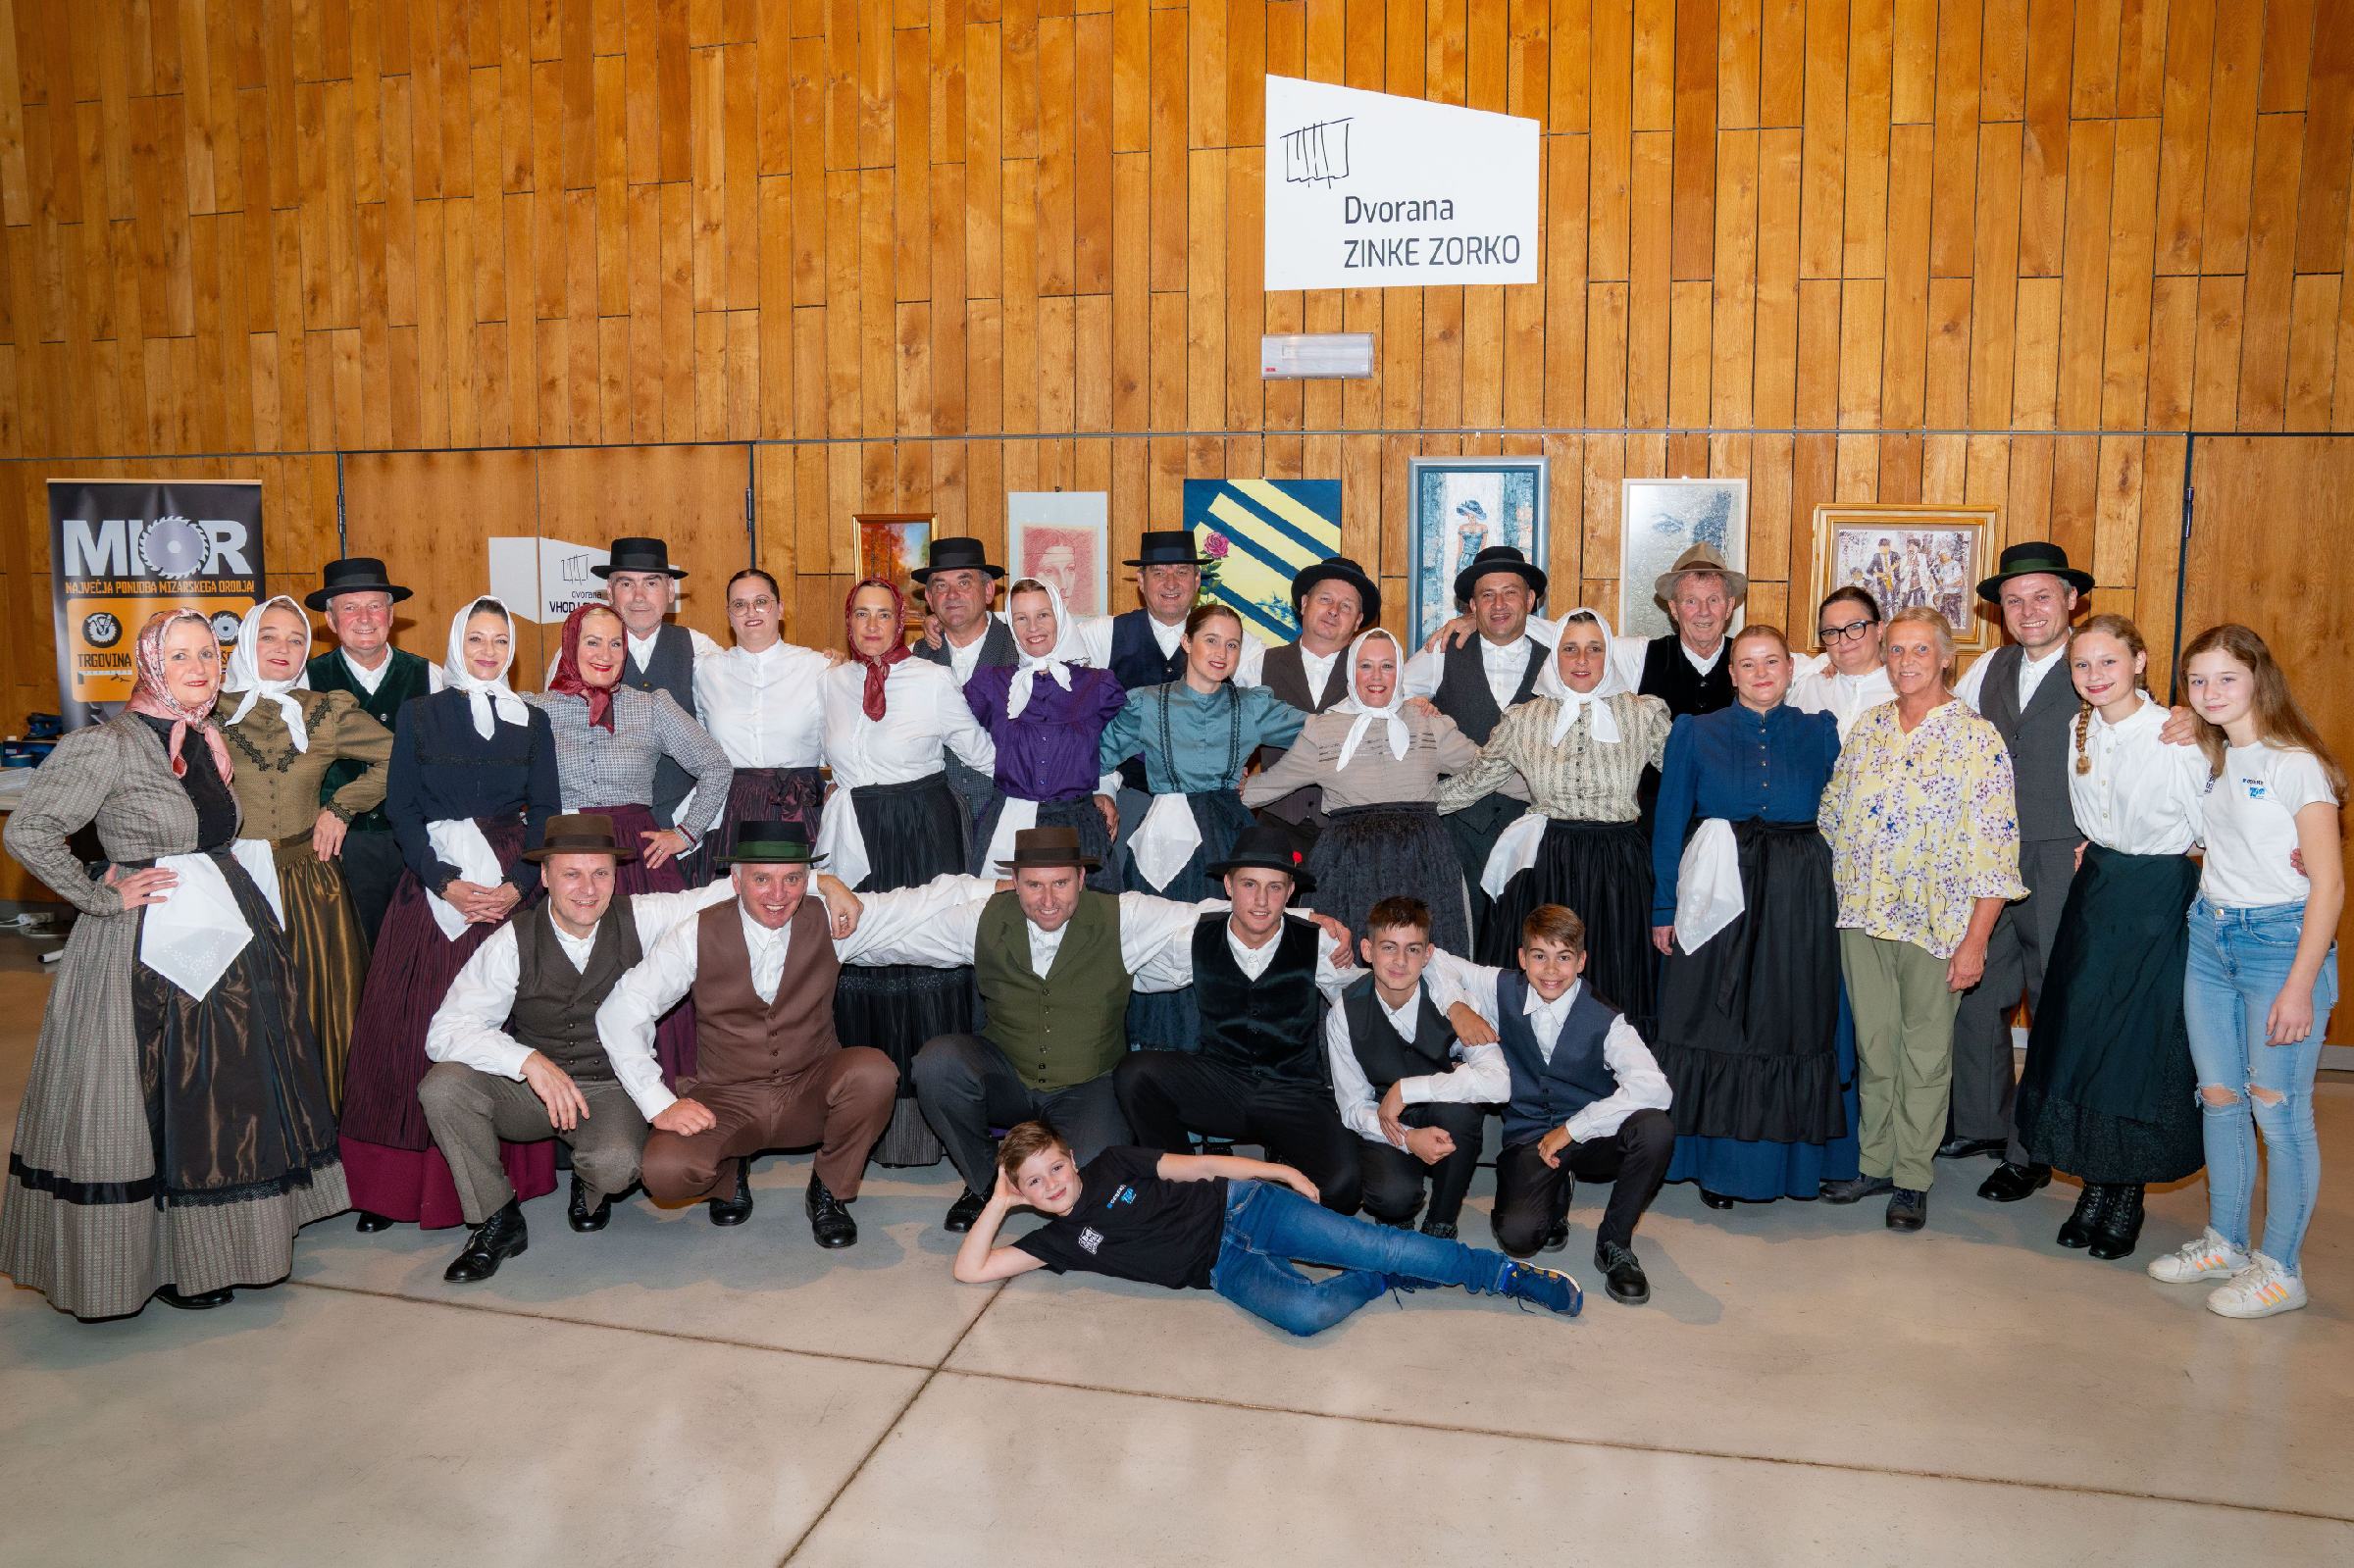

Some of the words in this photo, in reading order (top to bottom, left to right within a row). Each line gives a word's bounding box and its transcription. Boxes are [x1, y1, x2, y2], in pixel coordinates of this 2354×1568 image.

[1345, 195, 1454, 225] Dvorana
[1344, 237, 1420, 269] ZINKE
[1428, 234, 1520, 266] ZORKO
[115, 581, 157, 594] PONUDBA
[549, 601, 576, 613] VHOD
[77, 652, 131, 668] TRGOVINA
